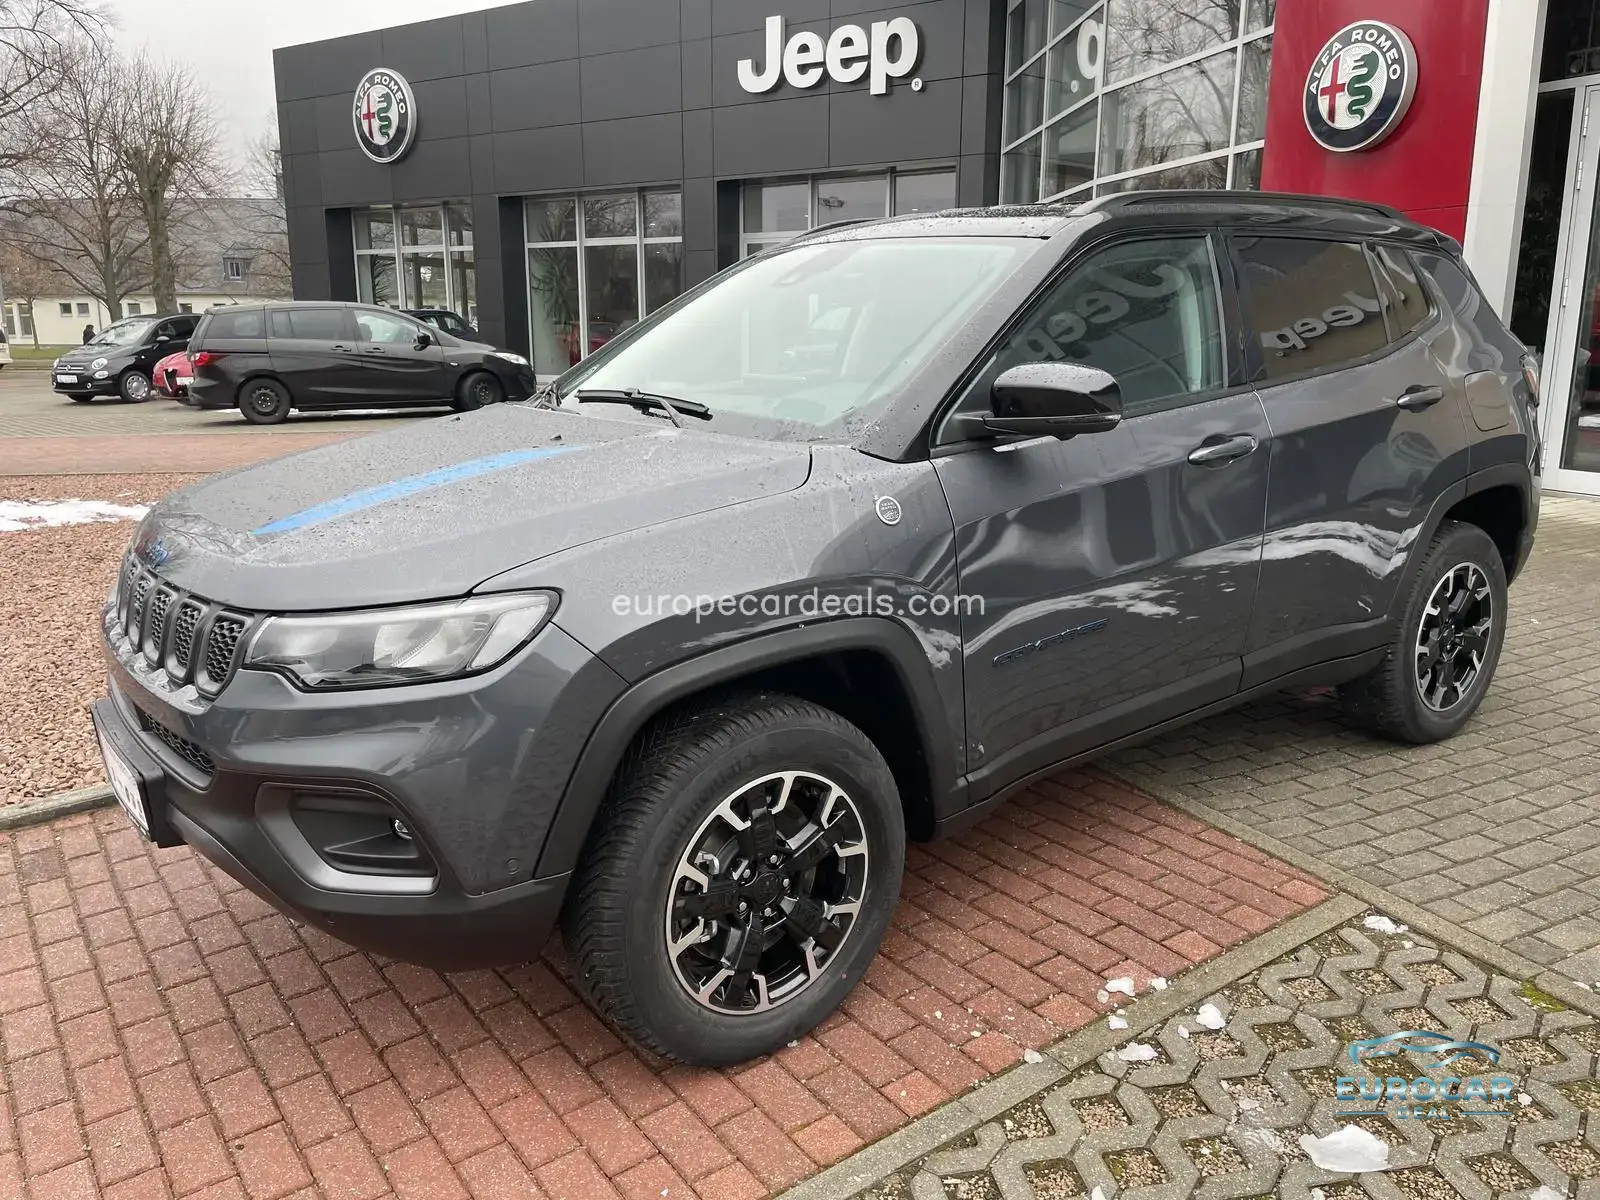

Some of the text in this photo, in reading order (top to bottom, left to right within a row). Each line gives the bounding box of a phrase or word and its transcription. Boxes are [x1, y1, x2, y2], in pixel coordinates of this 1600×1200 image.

[737, 15, 919, 95] Jeep
[1310, 29, 1401, 94] ALFA ROMEO
[355, 75, 406, 118] ALFA ROMEO
